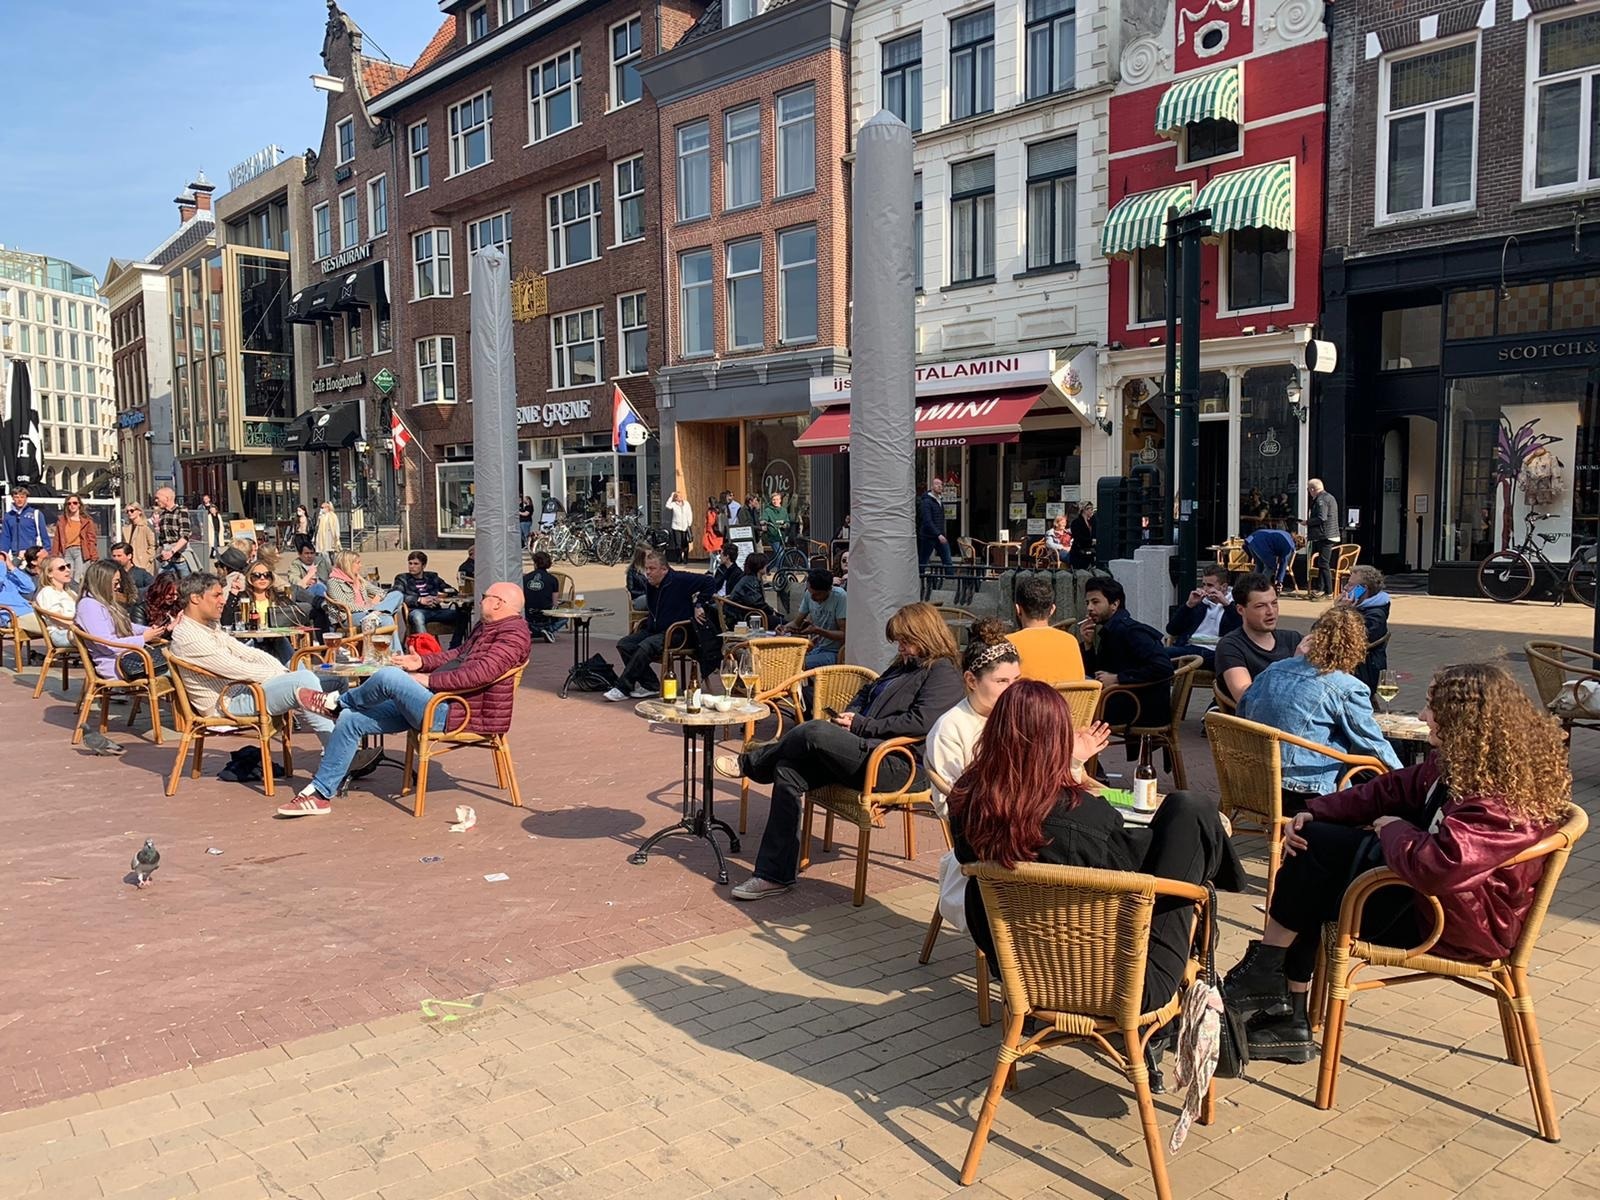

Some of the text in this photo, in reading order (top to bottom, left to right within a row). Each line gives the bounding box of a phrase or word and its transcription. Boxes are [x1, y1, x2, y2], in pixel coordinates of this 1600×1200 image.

[228, 144, 276, 191] WERKMAN
[321, 243, 371, 274] RESTAURANT
[915, 358, 1019, 381] TALAMINI
[542, 400, 592, 428] GRENE
[917, 437, 967, 447] Italiano
[765, 475, 790, 499] Vic
